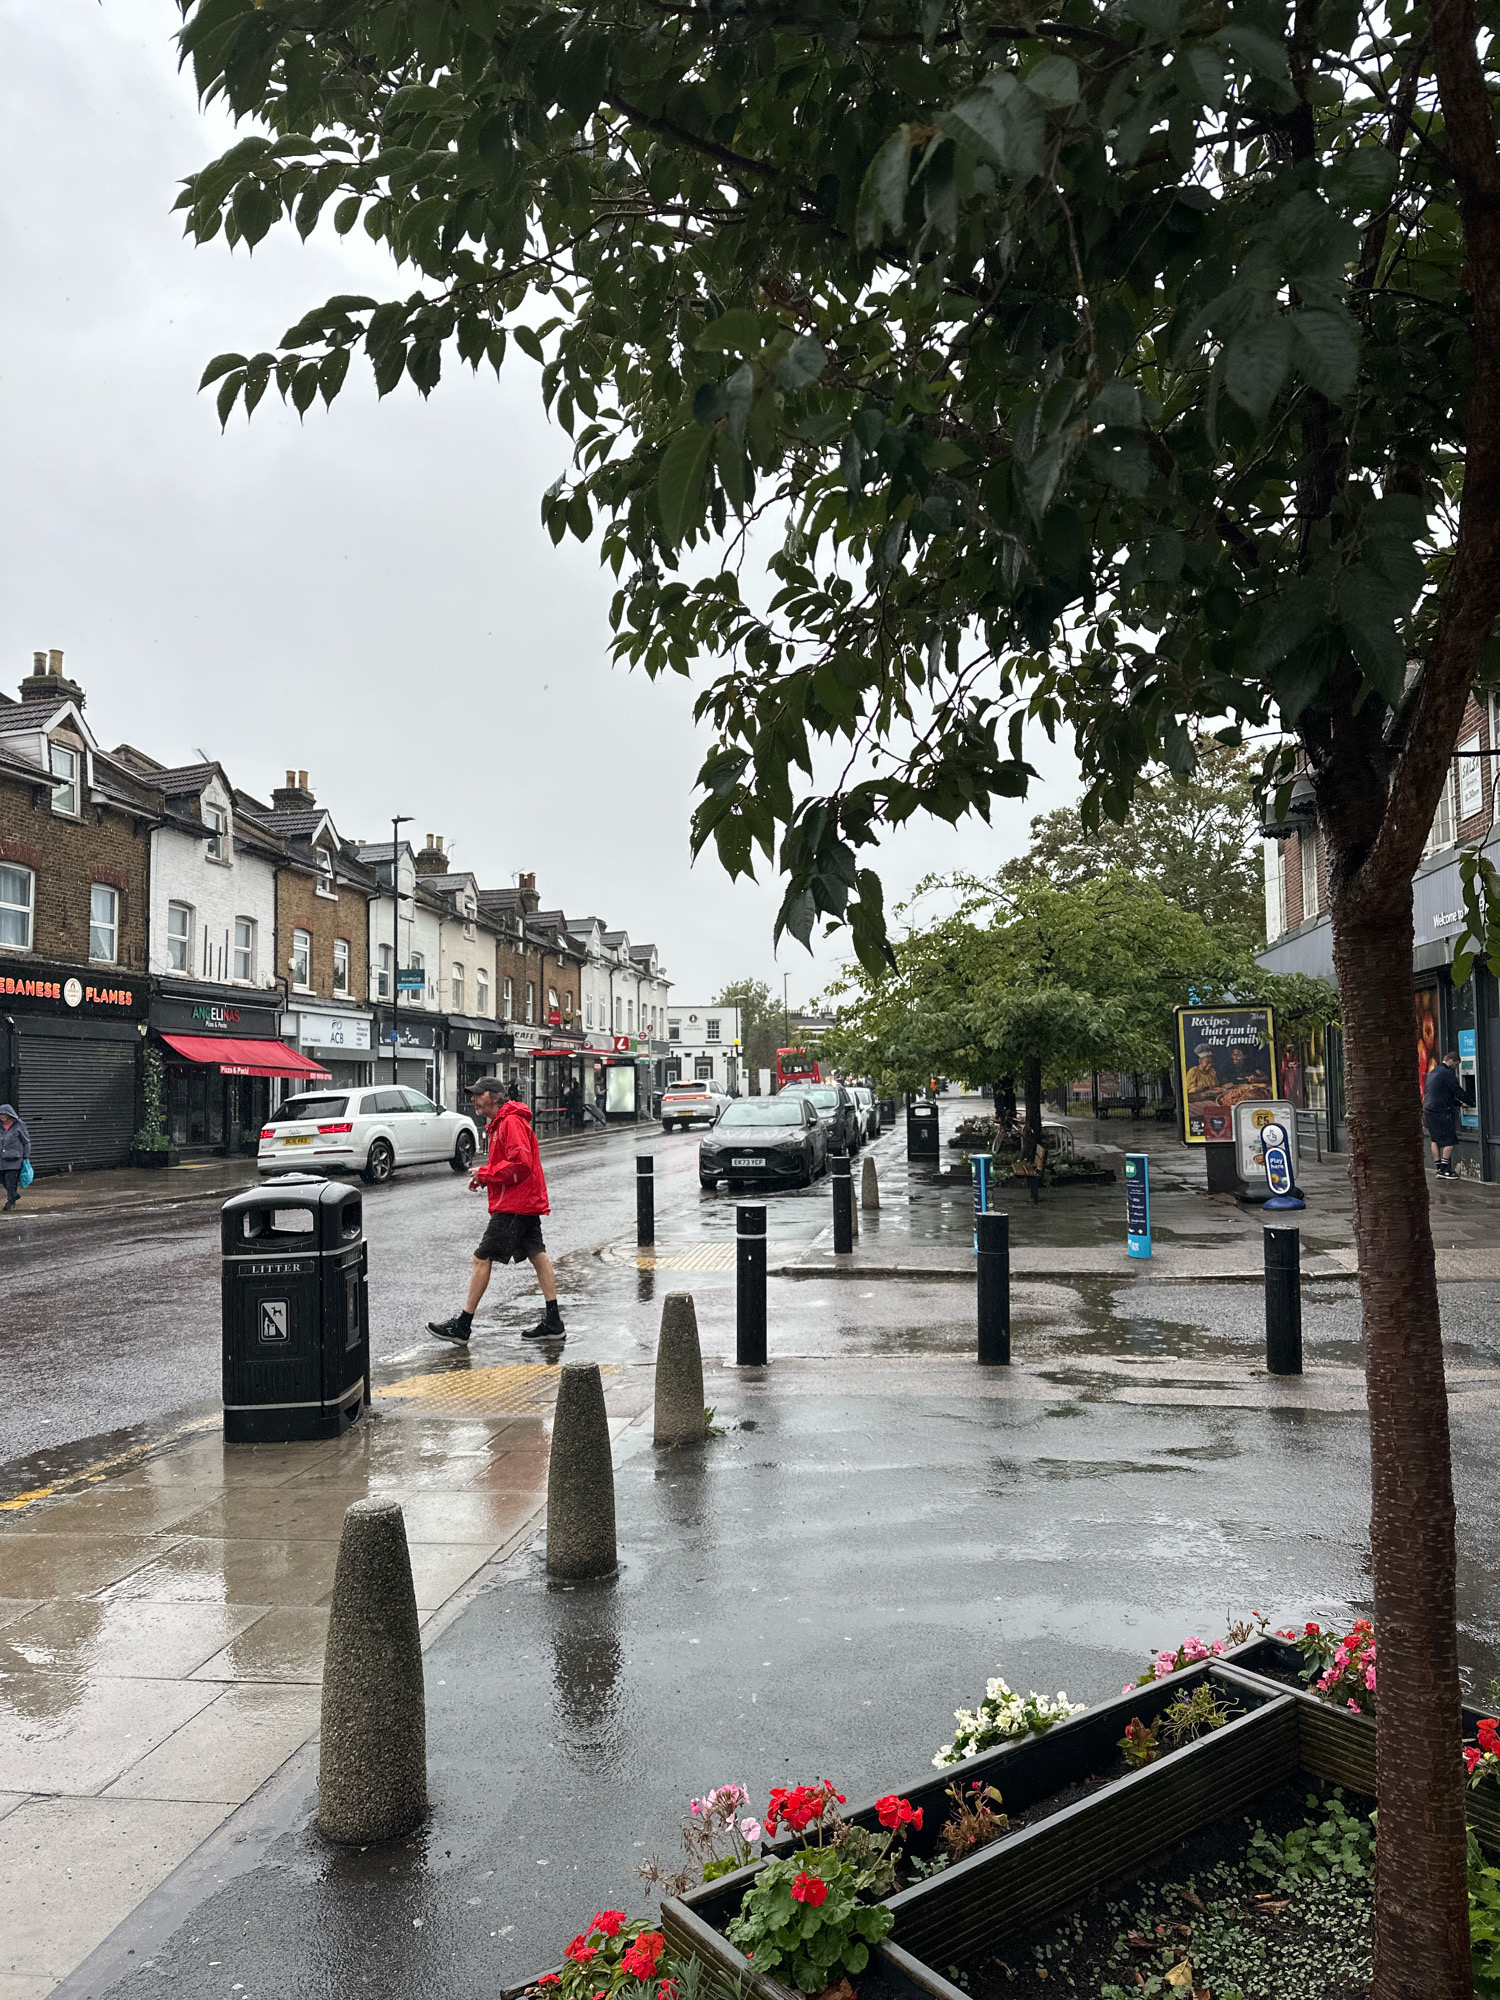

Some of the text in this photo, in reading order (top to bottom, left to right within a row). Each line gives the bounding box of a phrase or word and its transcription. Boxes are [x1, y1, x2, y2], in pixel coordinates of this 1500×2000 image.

[1462, 757, 1480, 779] SALSA
[1433, 908, 1464, 928] Welcome to
[85, 986, 133, 1006] FLAMES
[192, 1006, 241, 1023] ANGELINAS
[1191, 1016, 1231, 1028] Recipes
[514, 1031, 534, 1040] CAFE
[1201, 1024, 1257, 1036] that run in
[330, 1032, 344, 1044] ACB
[1208, 1034, 1260, 1047] the family
[220, 1066, 232, 1074] Pizza
[1257, 1115, 1270, 1126] £5
[252, 1263, 301, 1274] LITTER
